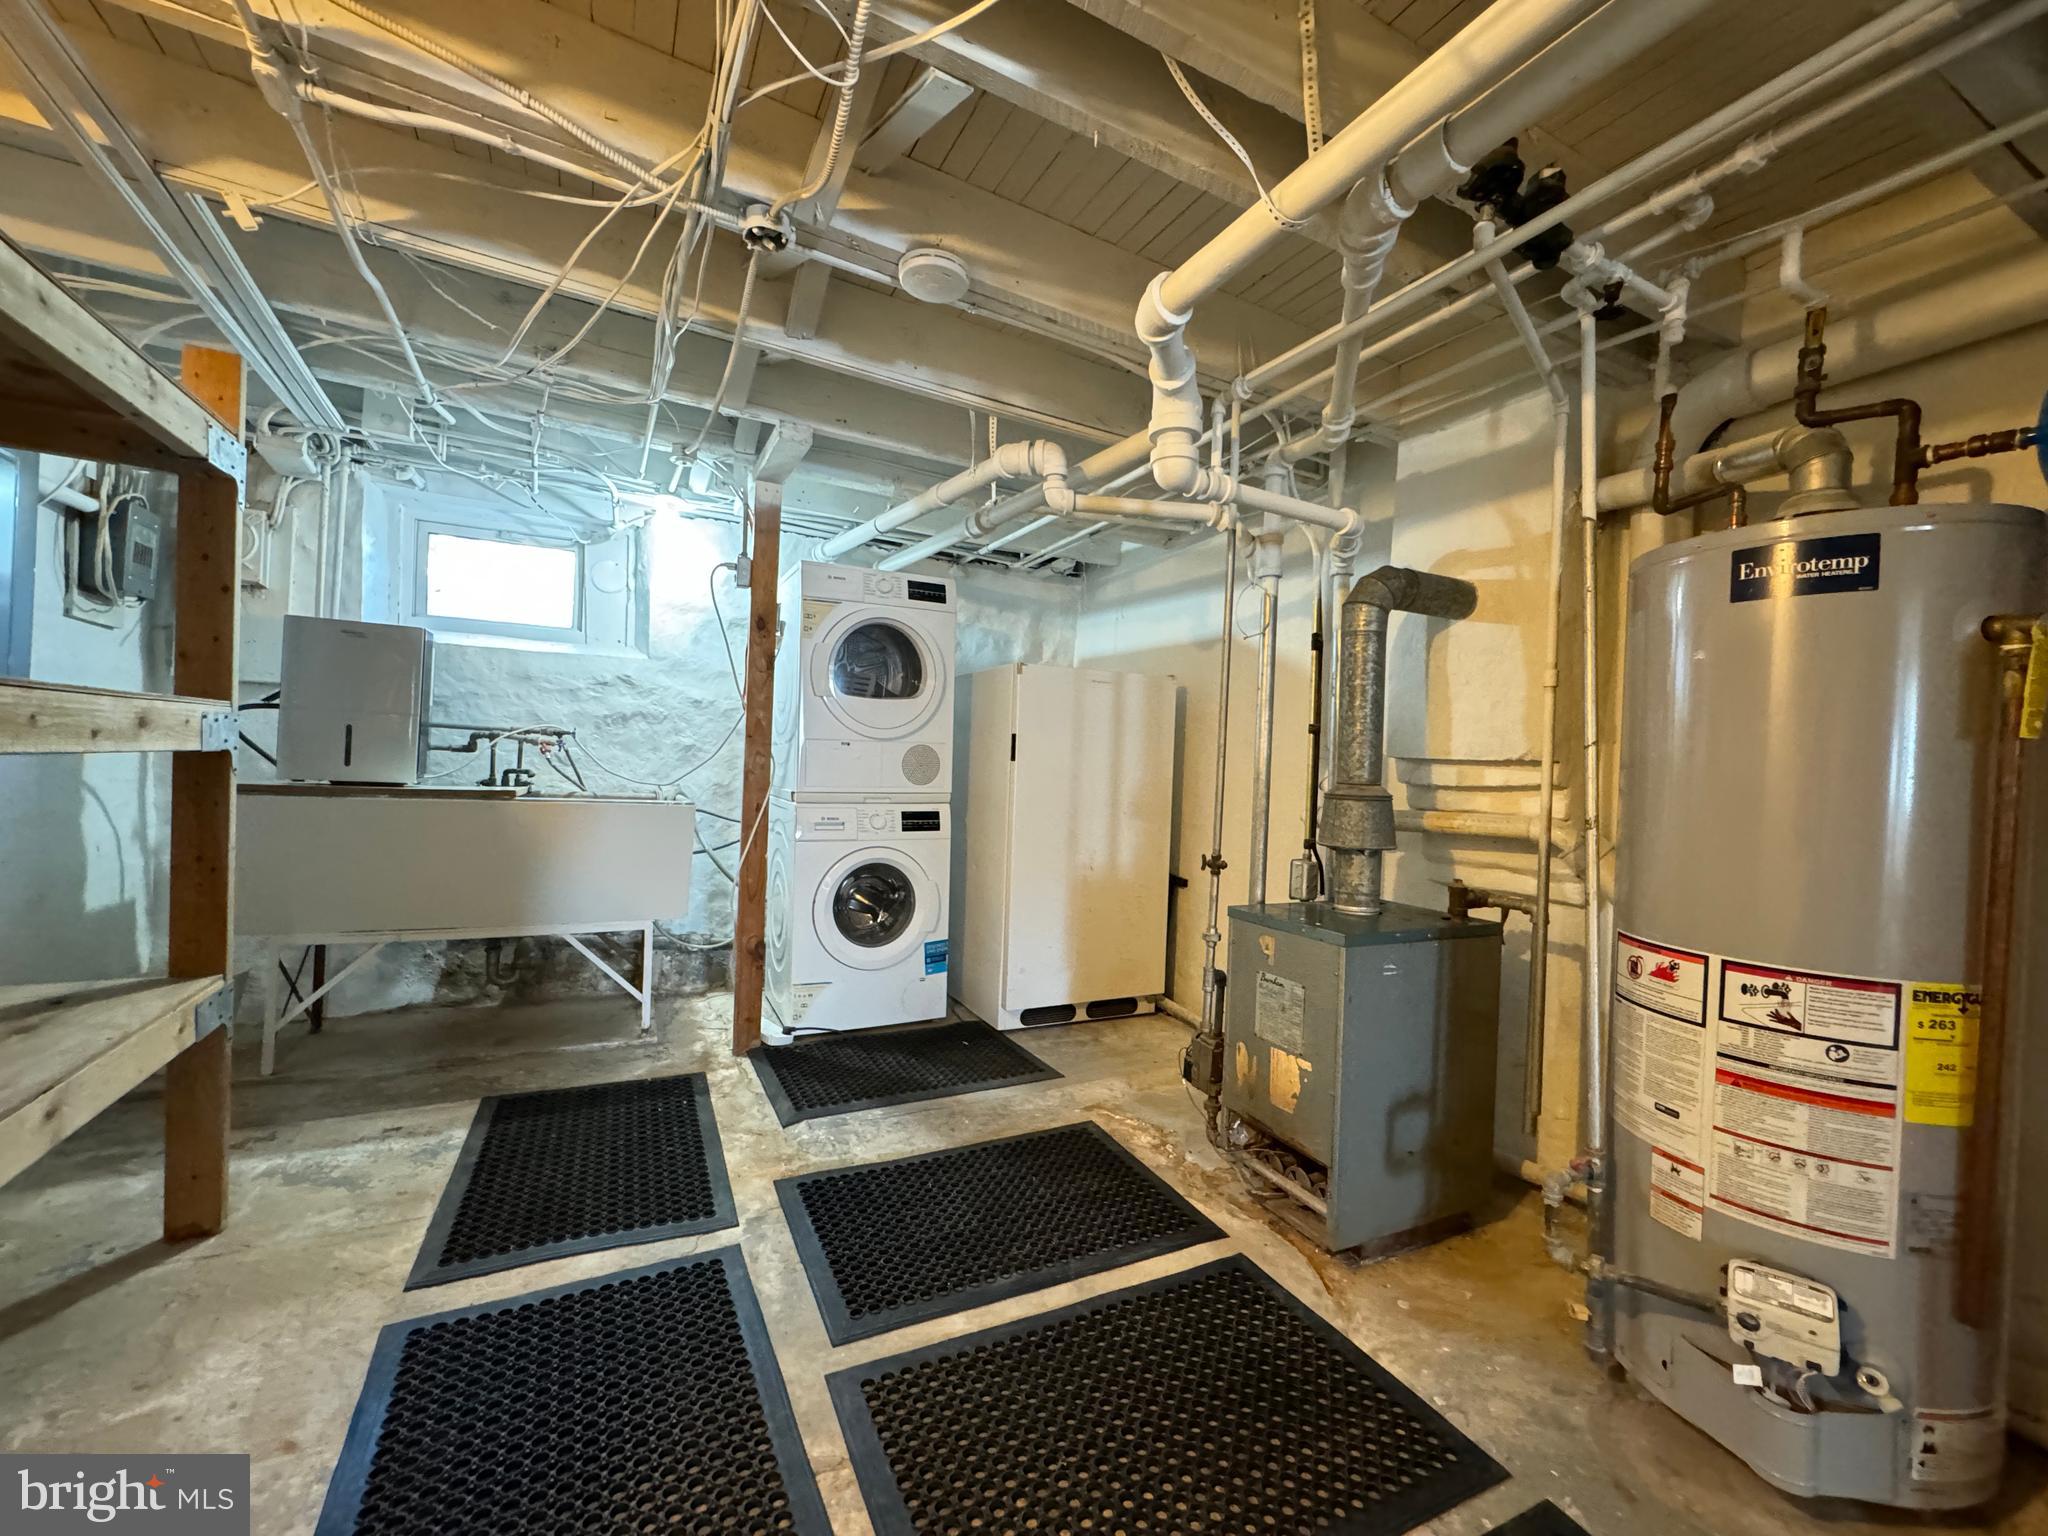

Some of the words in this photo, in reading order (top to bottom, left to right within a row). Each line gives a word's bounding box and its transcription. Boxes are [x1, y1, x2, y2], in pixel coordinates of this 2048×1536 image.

[1738, 555, 1870, 581] Envirotemp
[1796, 976, 1833, 987] DANGER
[1928, 1019, 1956, 1031] 263
[1937, 1063, 1957, 1072] 242
